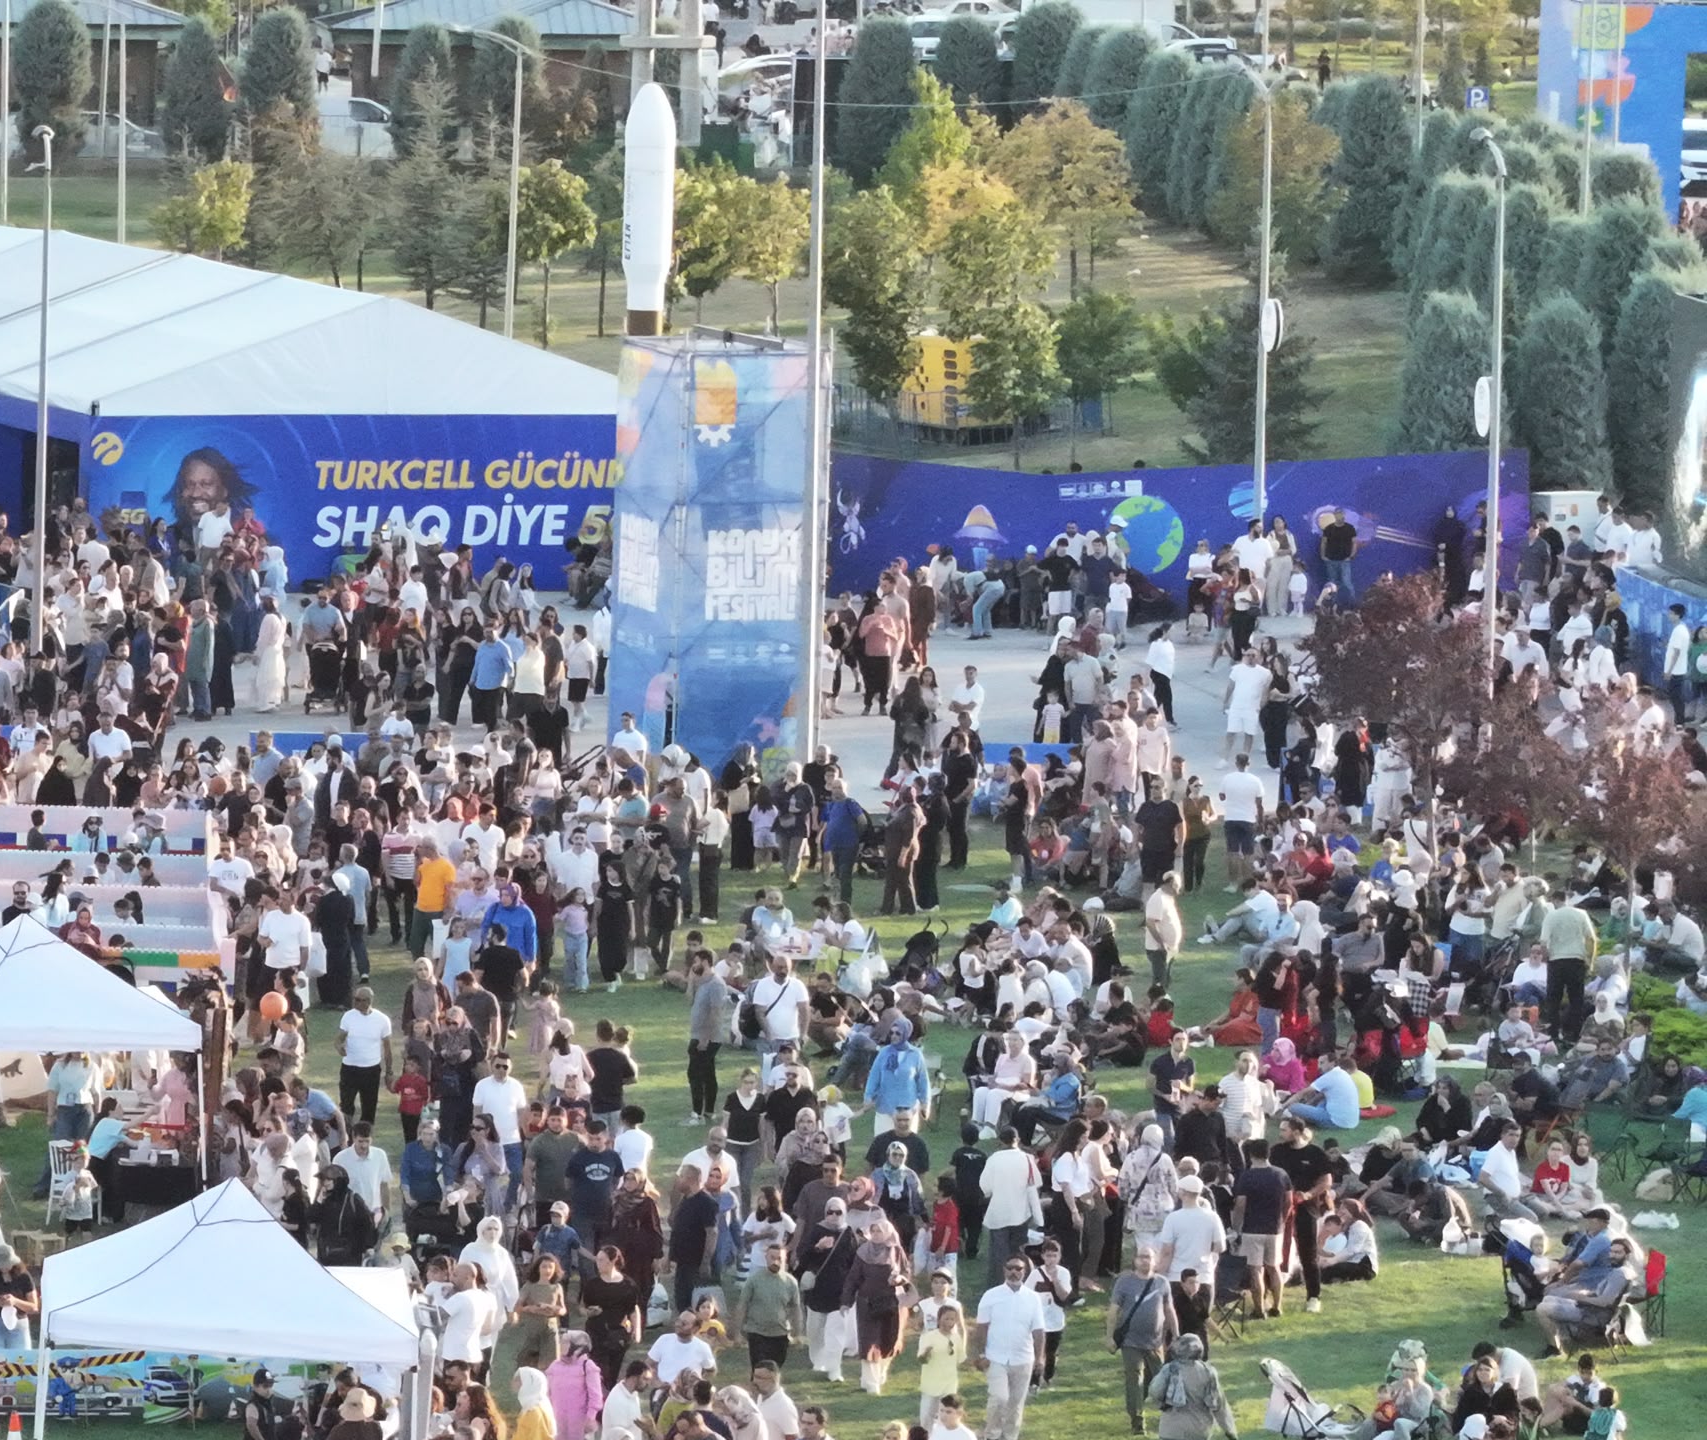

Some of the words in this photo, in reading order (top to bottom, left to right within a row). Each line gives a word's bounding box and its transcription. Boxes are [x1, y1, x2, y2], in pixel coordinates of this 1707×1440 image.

[315, 459, 475, 490] TURKCELL
[462, 493, 569, 546] DİYE
[577, 505, 614, 545] 5
